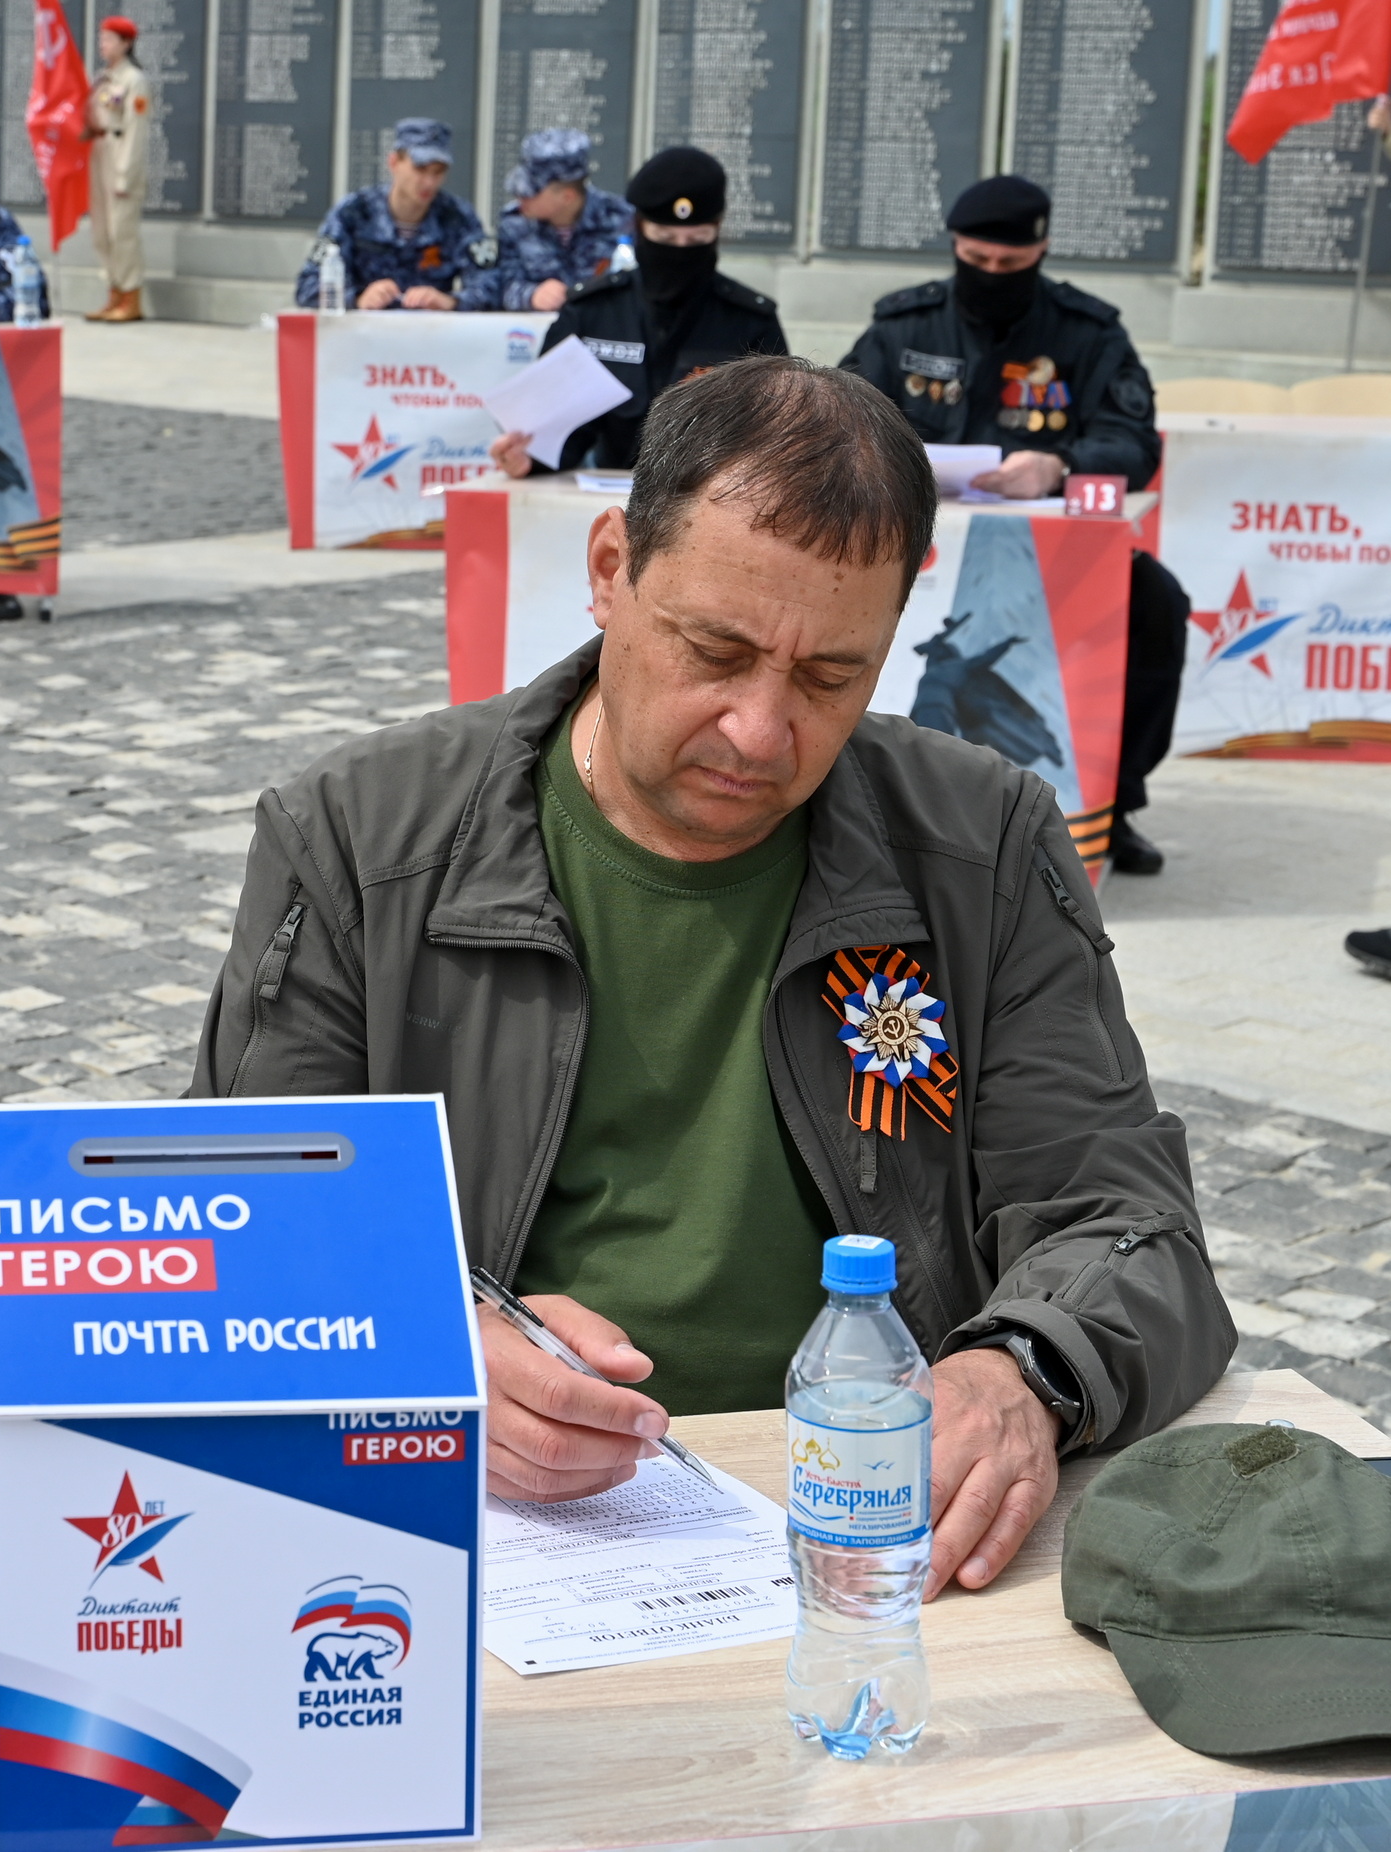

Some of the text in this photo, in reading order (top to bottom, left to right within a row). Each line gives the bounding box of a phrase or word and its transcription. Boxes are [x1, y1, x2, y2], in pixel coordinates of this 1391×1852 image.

[365, 364, 456, 391] ЗНАТЬ,
[391, 394, 449, 408] ЧТОБЫ
[1082, 482, 1116, 511] 13
[1230, 502, 1362, 540] ЗНАТЬ,
[1269, 542, 1391, 565] ЧТОБЫ ПО
[72, 1315, 377, 1357] ПОЧТА РОССИИ
[350, 1434, 458, 1462] ГЕРОЮ
[793, 1464, 912, 1514] Серебряная
[143, 1500, 165, 1516] ЛЕТ
[100, 1512, 145, 1549] 80
[834, 1535, 848, 1545] ИЗ
[849, 1532, 915, 1546] ЗАПОВЕДНИКА
[77, 1596, 181, 1618] Диктант
[77, 1618, 183, 1656] ПОБЕДЫ
[587, 1614, 742, 1643] БЛАНК ОТВЕТОВ
[298, 1686, 403, 1709] ЕДИНАЯ
[298, 1708, 403, 1731] РОССИЯ
